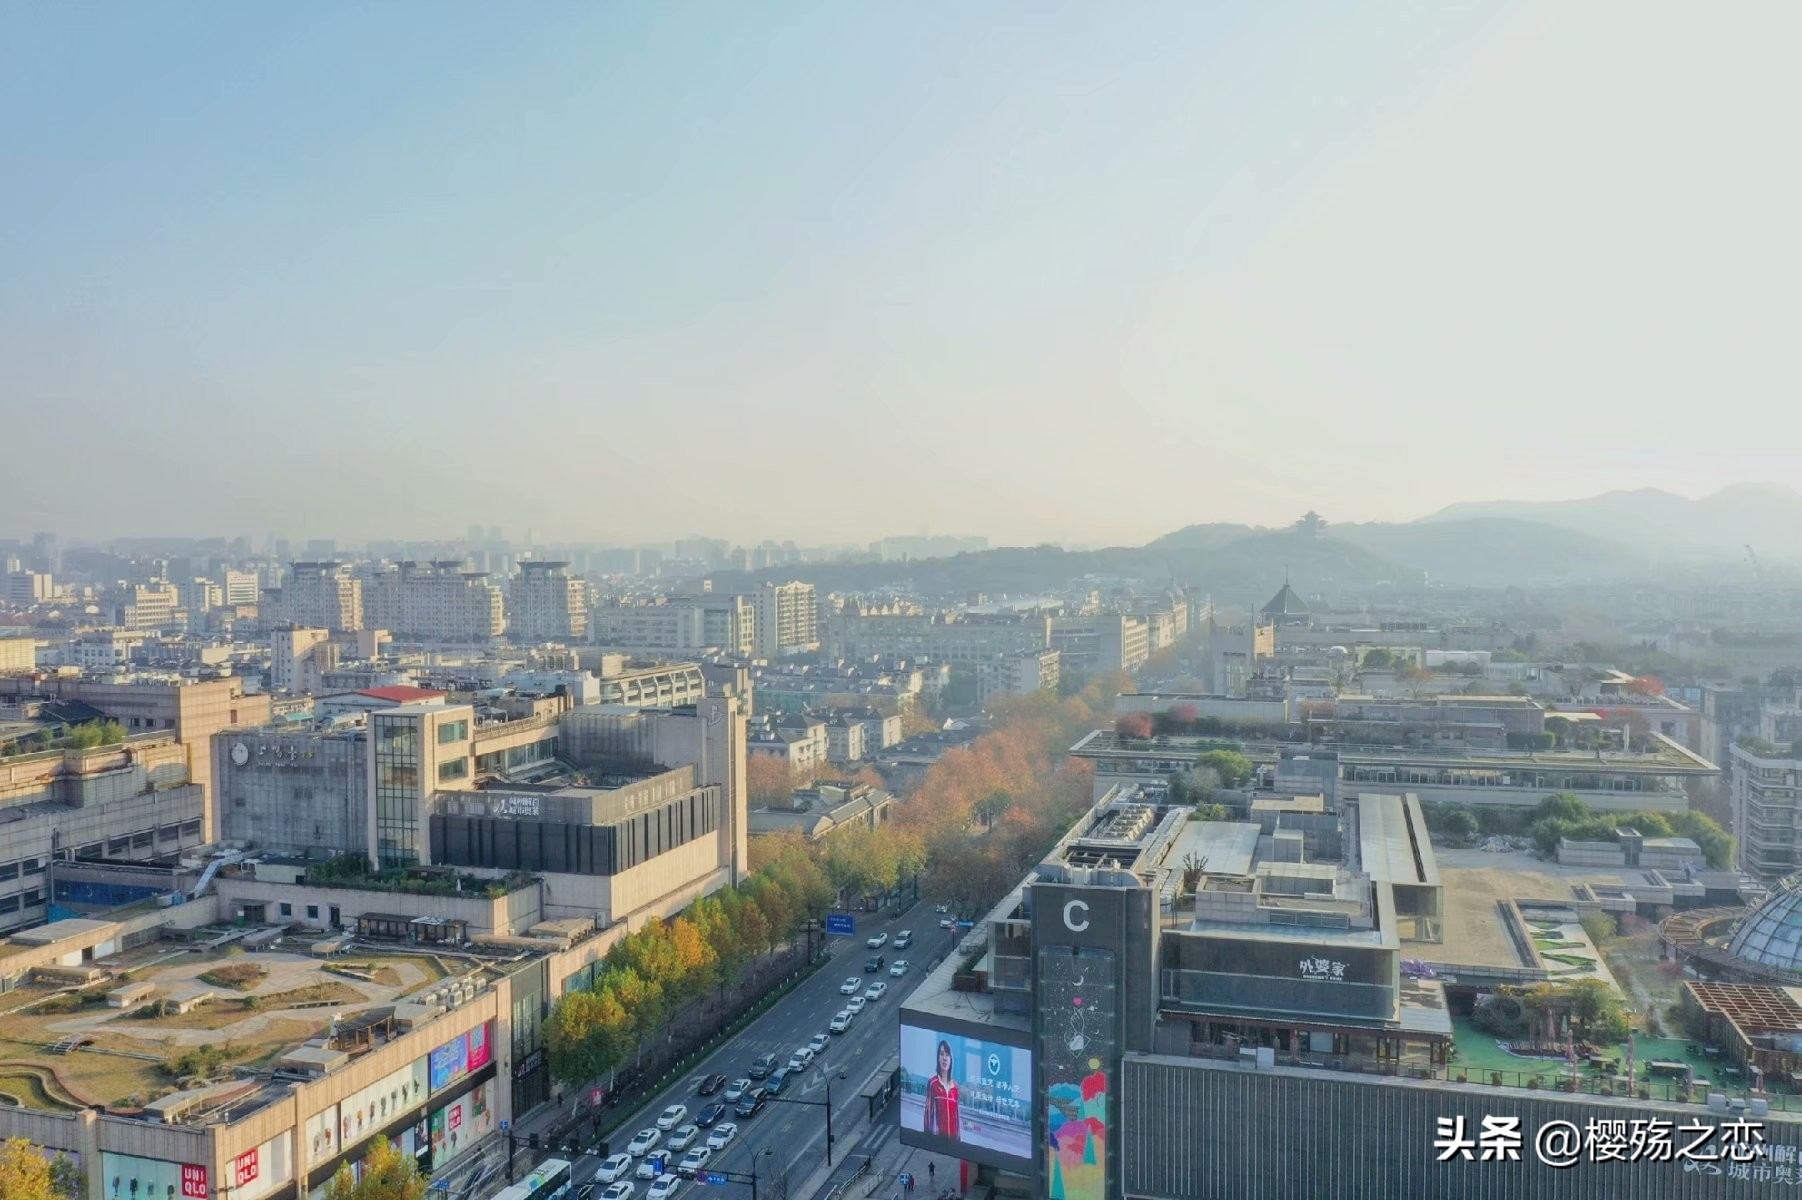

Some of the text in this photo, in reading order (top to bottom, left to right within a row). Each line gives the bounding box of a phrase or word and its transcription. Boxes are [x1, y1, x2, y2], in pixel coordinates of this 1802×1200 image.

[1063, 900, 1090, 932] C
[1300, 957, 1346, 976] 外婆家
[237, 1152, 255, 1169] UNI
[184, 1167, 204, 1182] UNI
[238, 1164, 256, 1184] QLO
[184, 1182, 206, 1195] QLO
